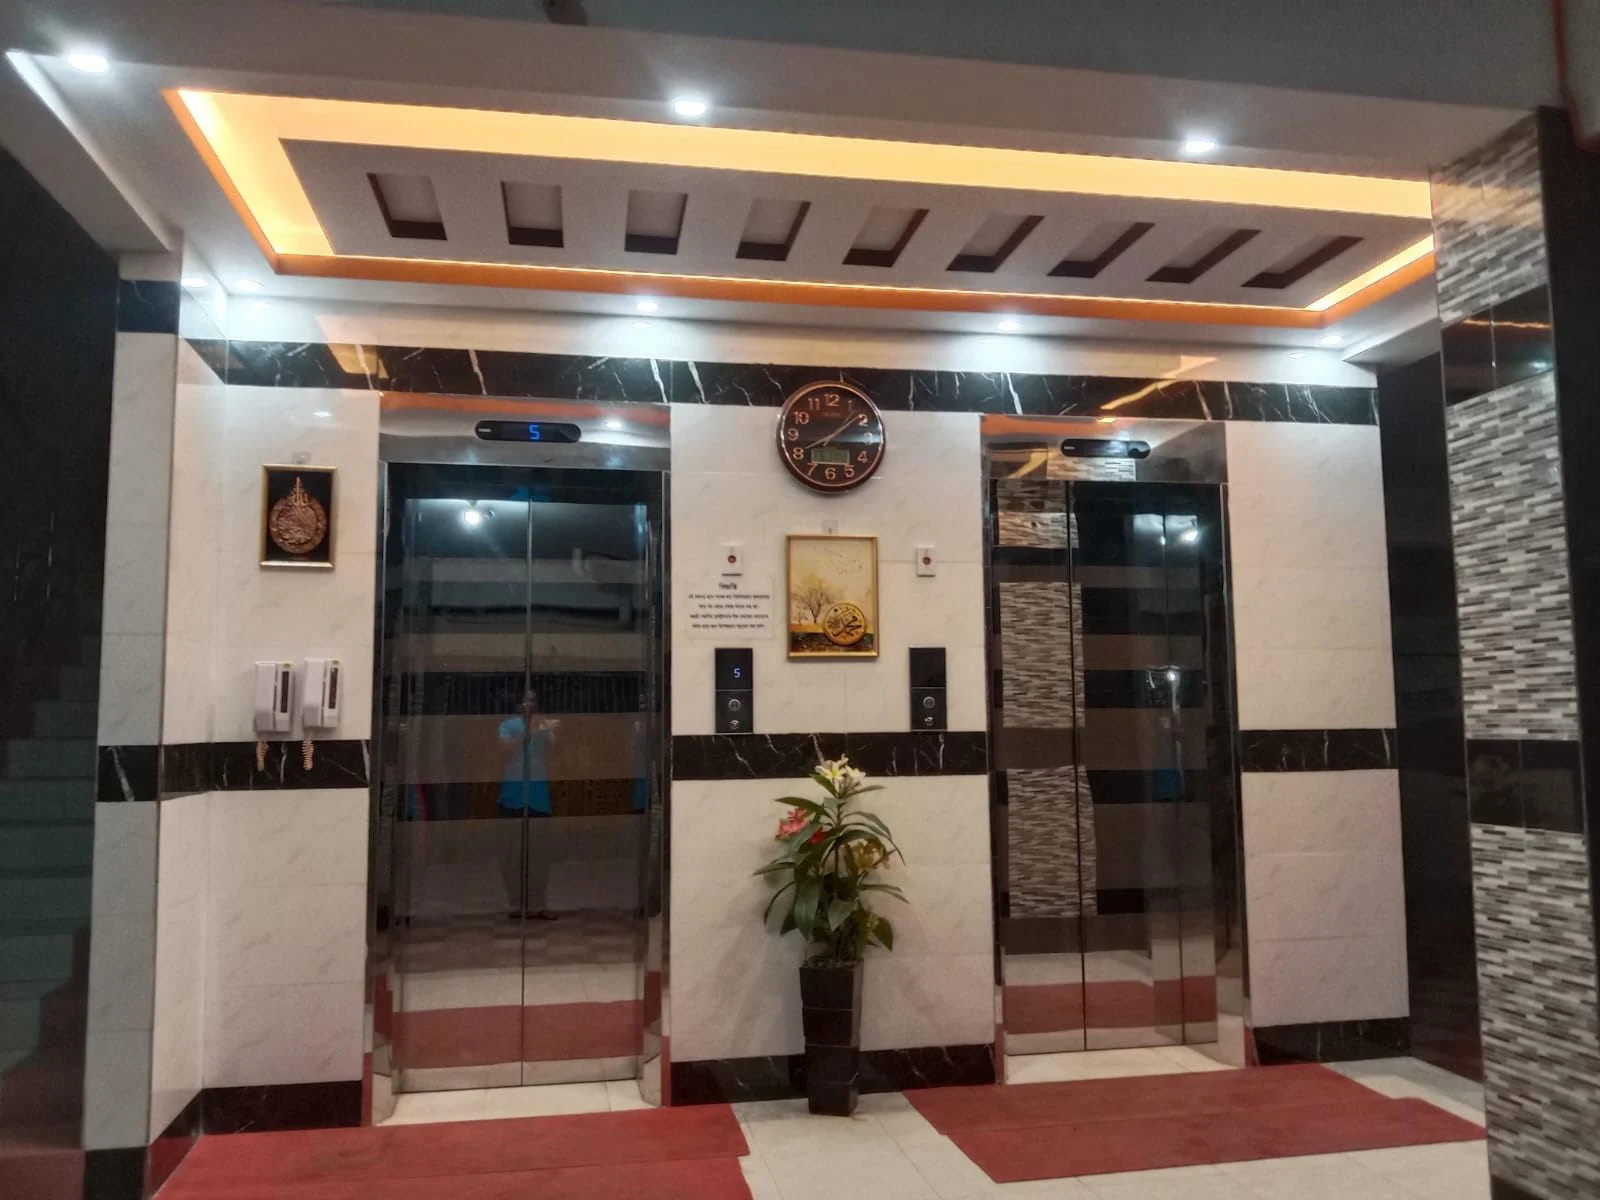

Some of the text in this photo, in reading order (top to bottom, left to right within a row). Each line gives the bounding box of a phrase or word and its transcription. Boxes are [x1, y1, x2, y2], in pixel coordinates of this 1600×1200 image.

[808, 398, 820, 411] 11
[824, 393, 840, 407] 12
[793, 411, 809, 425] 10
[858, 414, 868, 427] 2
[528, 424, 540, 440] 5
[788, 428, 799, 441] 9
[863, 432, 873, 445] 3
[793, 447, 804, 460] 8
[857, 450, 868, 464] 4
[808, 462, 818, 476] 7
[825, 467, 836, 480] 6
[844, 464, 855, 477] 5
[734, 667, 741, 678] 5
